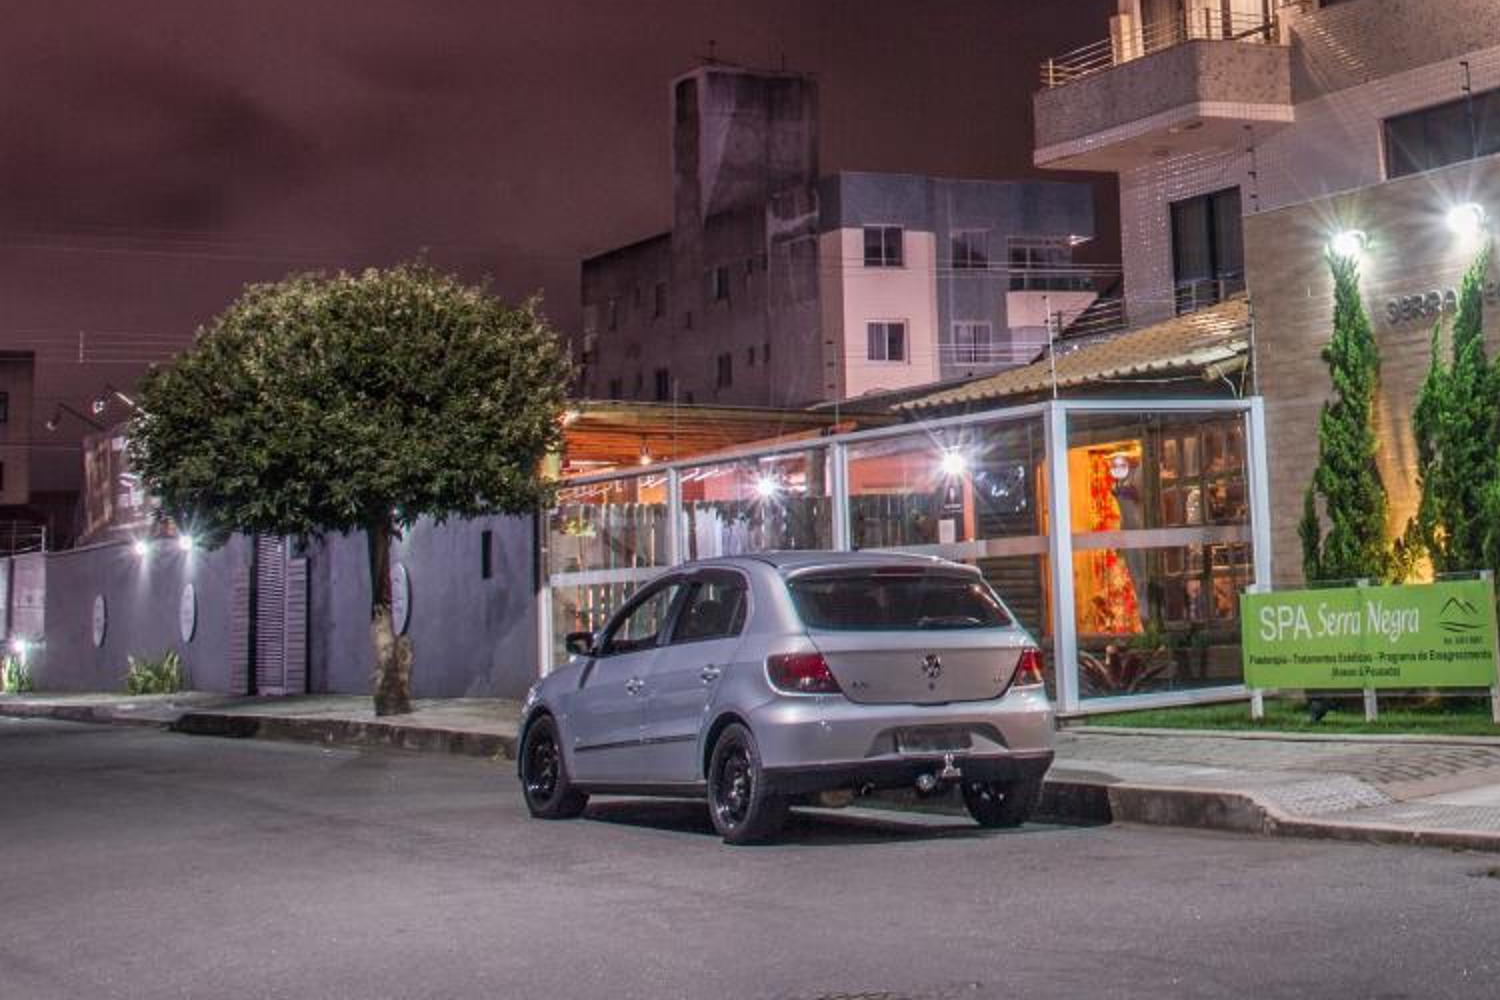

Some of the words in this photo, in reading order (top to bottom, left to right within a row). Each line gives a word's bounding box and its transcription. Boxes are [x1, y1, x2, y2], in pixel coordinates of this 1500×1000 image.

[1260, 605, 1312, 641] SPA
[1318, 602, 1361, 636] Serra
[1367, 600, 1419, 643] Negra
